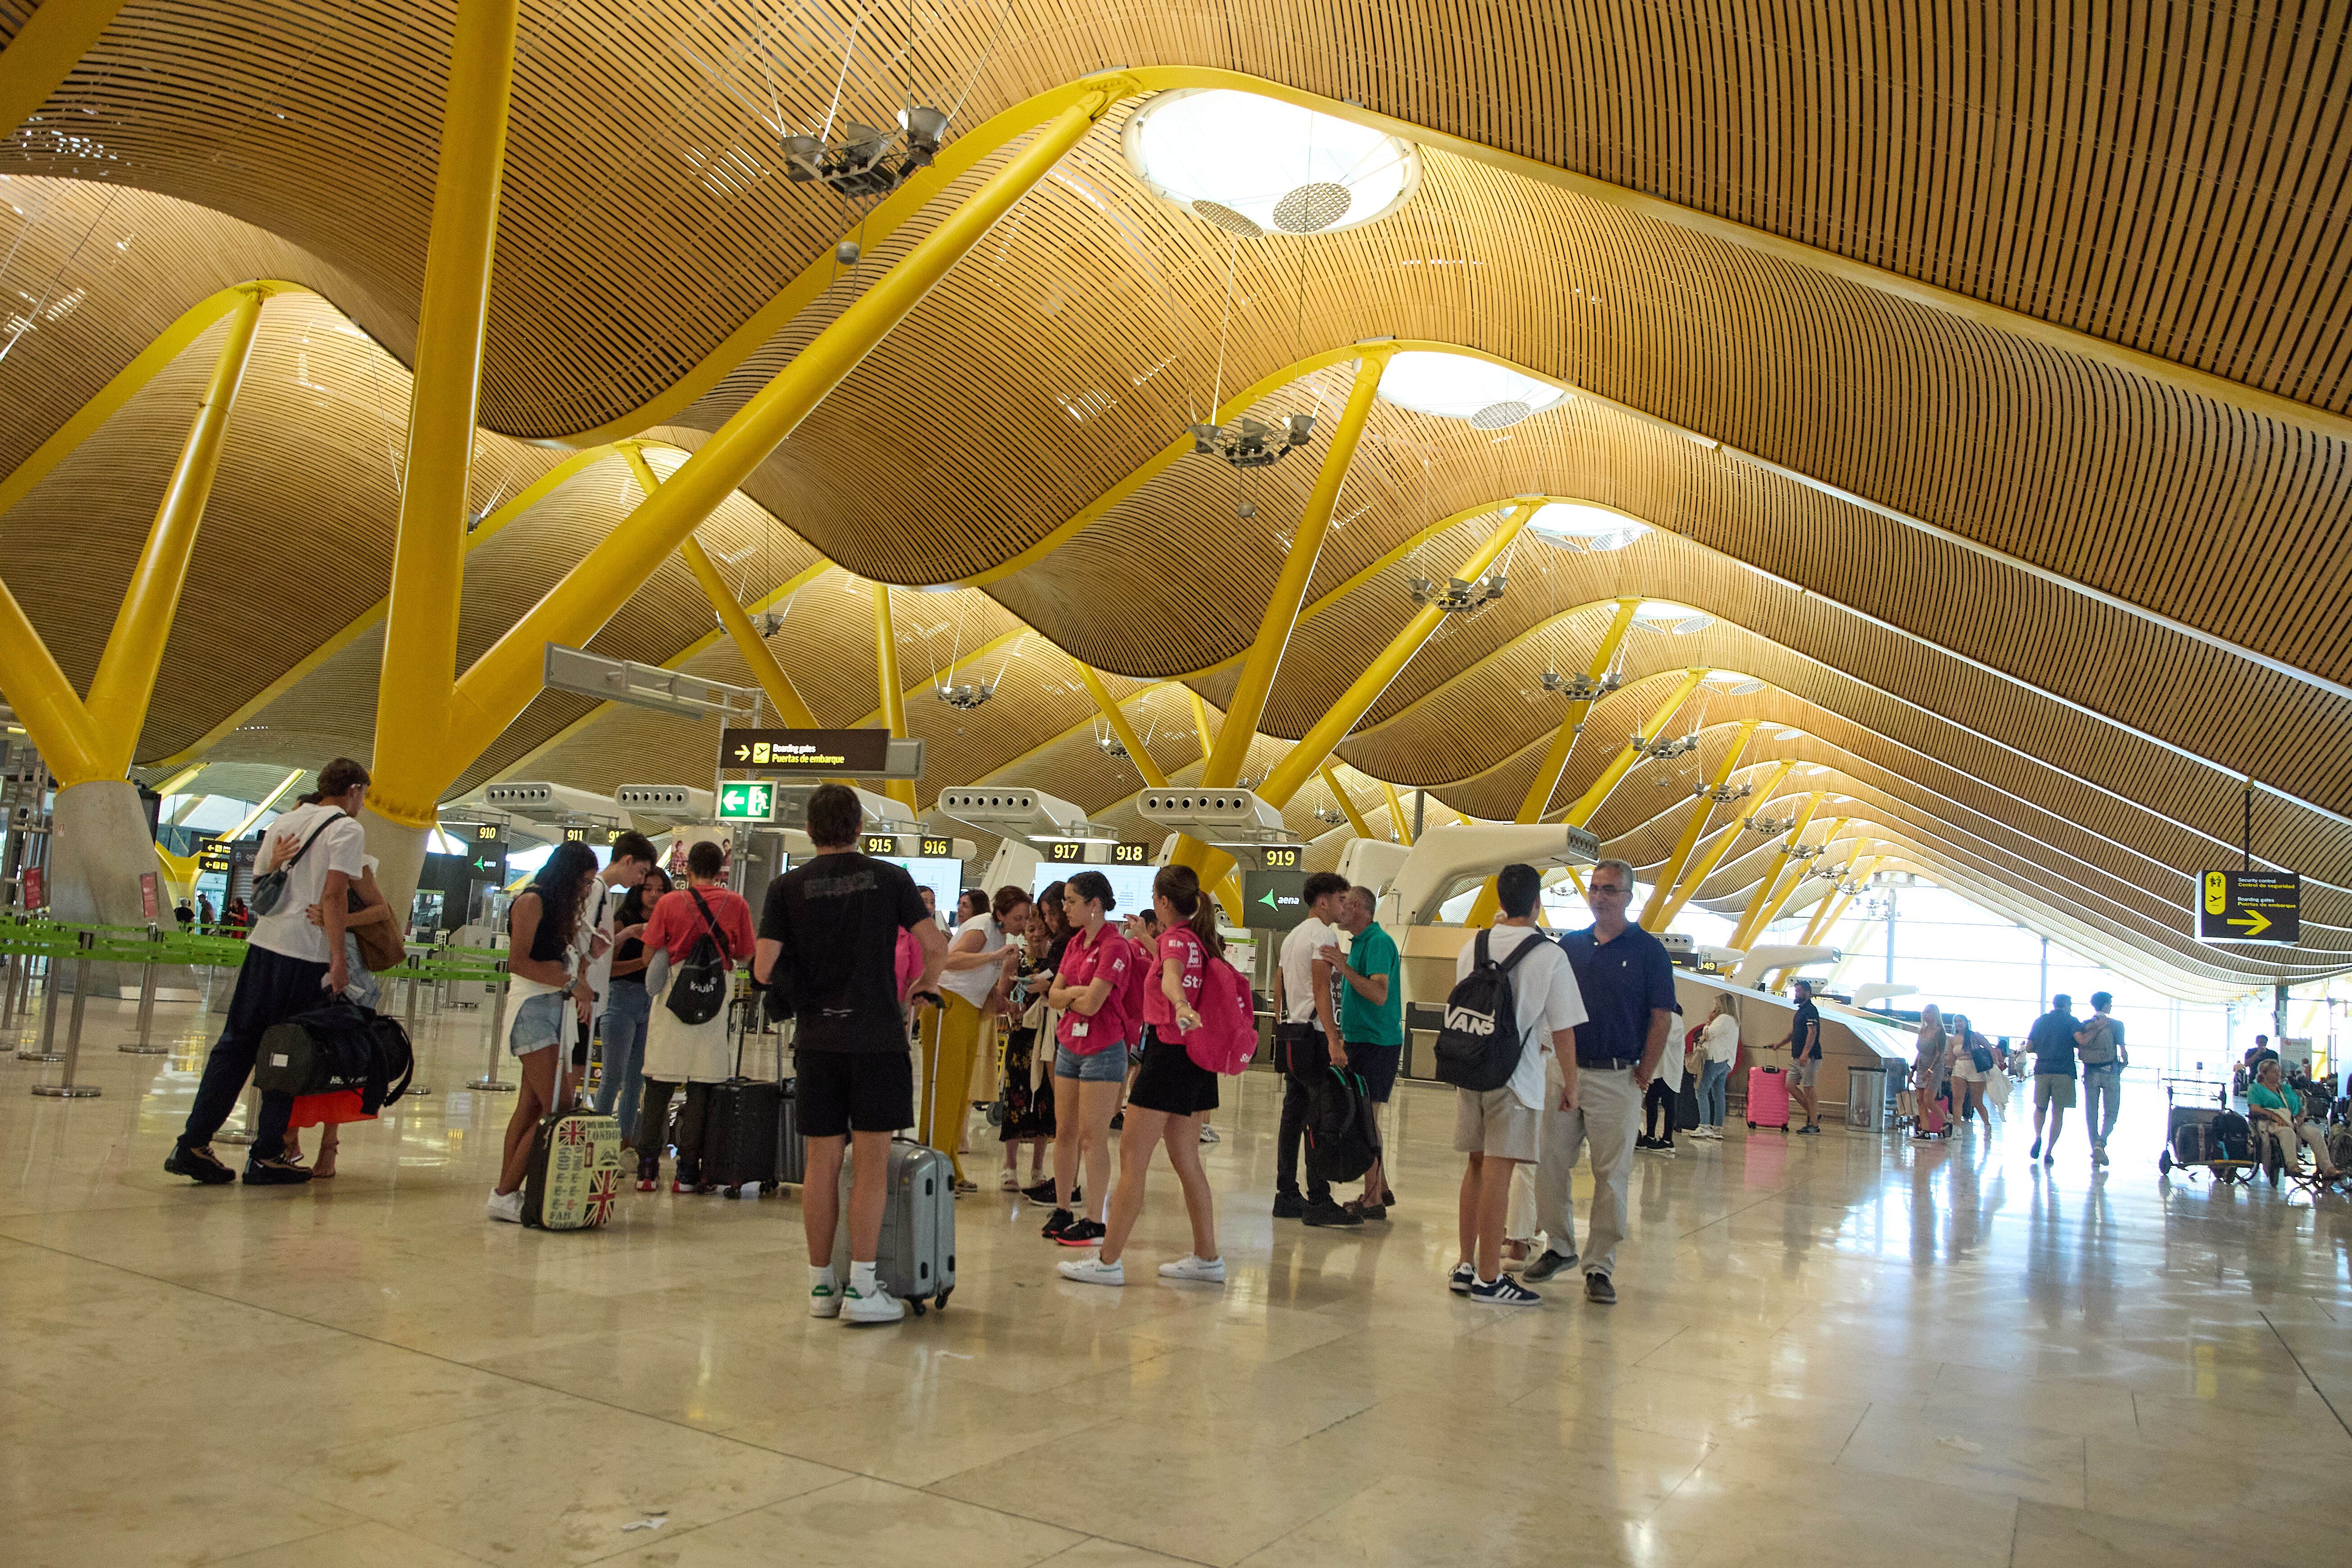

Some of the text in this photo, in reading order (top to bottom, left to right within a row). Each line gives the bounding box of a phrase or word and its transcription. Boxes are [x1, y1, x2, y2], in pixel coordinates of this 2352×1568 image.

[772, 744, 816, 754] Boarding gates
[772, 754, 845, 765] Puertas de embarque
[479, 827, 496, 839] 910
[567, 829, 583, 841] 911
[608, 830, 625, 843] 91
[869, 838, 892, 852] 915
[924, 840, 946, 855] 916
[1054, 844, 1079, 859] 917
[1116, 846, 1143, 861] 918
[1267, 850, 1295, 866] 919
[1277, 897, 1300, 905] aena
